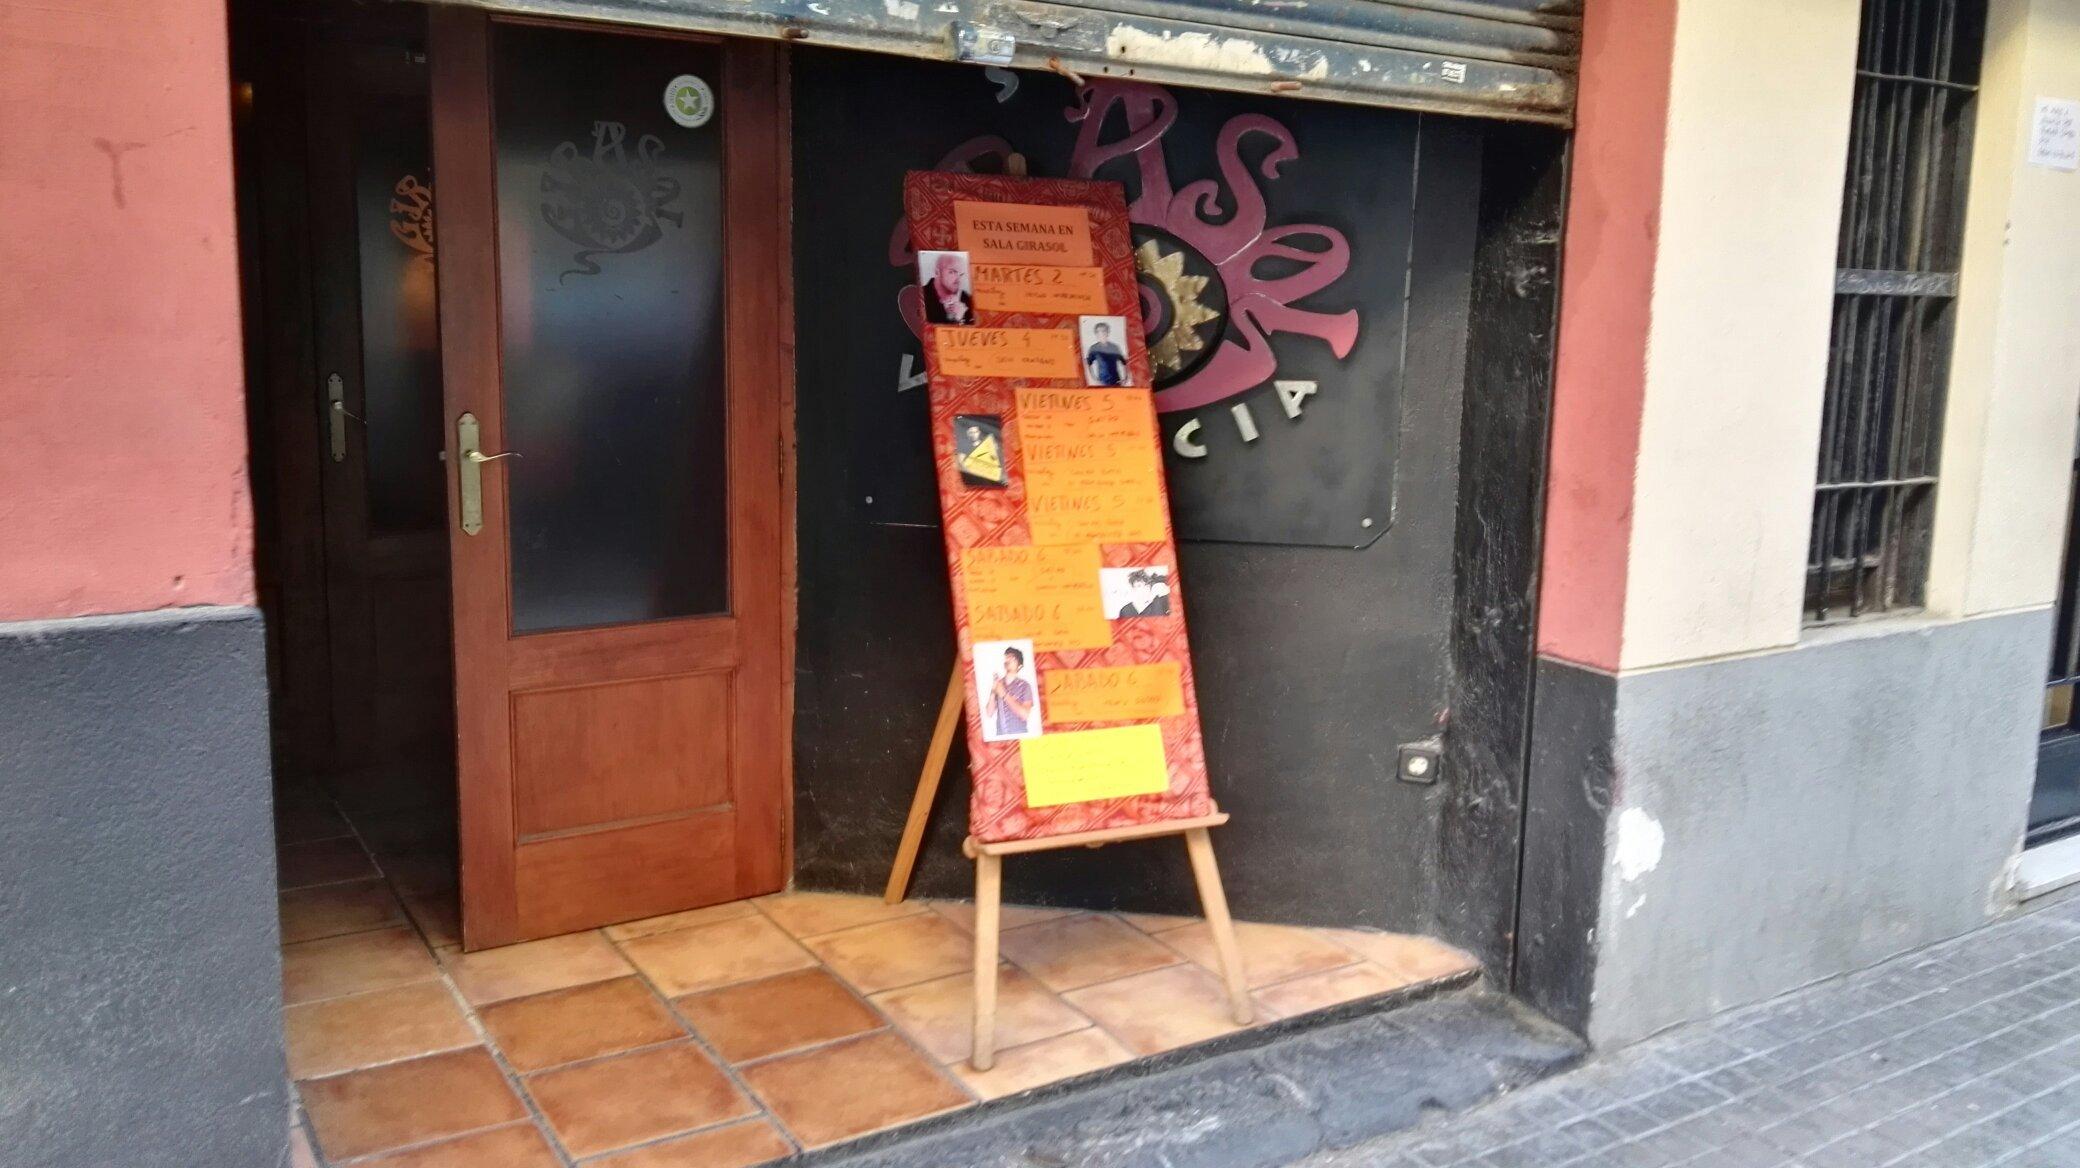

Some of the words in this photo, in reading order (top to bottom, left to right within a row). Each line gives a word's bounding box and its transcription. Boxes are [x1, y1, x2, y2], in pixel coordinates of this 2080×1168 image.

[972, 219, 1004, 233] ESTA
[1005, 221, 1058, 236] SEMANA
[1058, 224, 1074, 236] EN
[983, 237, 1015, 250] SALA
[1016, 240, 1068, 253] GIRASOL
[974, 266, 1043, 286] MARTES
[1052, 269, 1064, 285] 2
[941, 329, 1008, 348] JUEVES
[1021, 330, 1032, 348] 4
[1020, 393, 1092, 411] VIERNES
[1101, 393, 1115, 411] 5
[1105, 443, 1117, 459] 5
[1112, 495, 1126, 510] 5
[1052, 603, 1062, 620] 6
